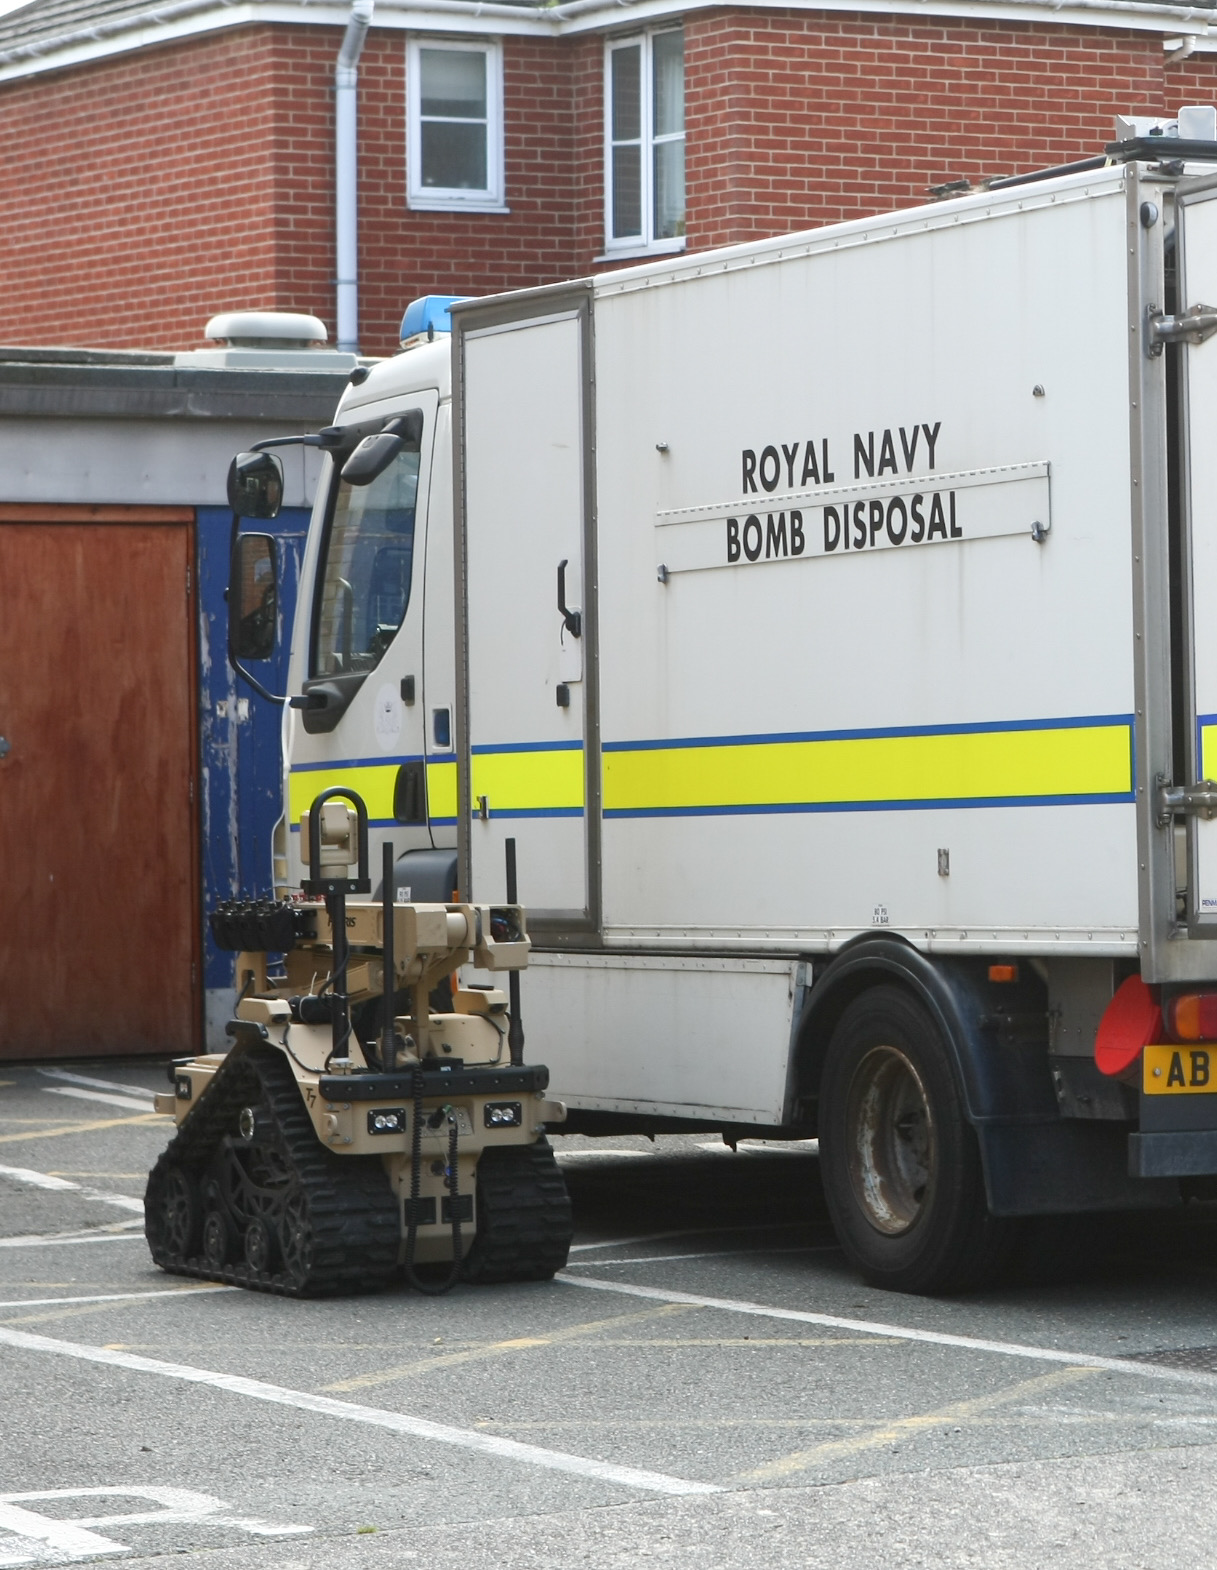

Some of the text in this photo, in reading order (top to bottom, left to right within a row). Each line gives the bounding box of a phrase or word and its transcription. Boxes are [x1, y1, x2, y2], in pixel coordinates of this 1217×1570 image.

[741, 421, 942, 494] ROYAL NAVY
[726, 490, 963, 563] BOMB DISPOSAL
[1166, 1051, 1210, 1087] AB
[305, 1087, 317, 1109] T7
